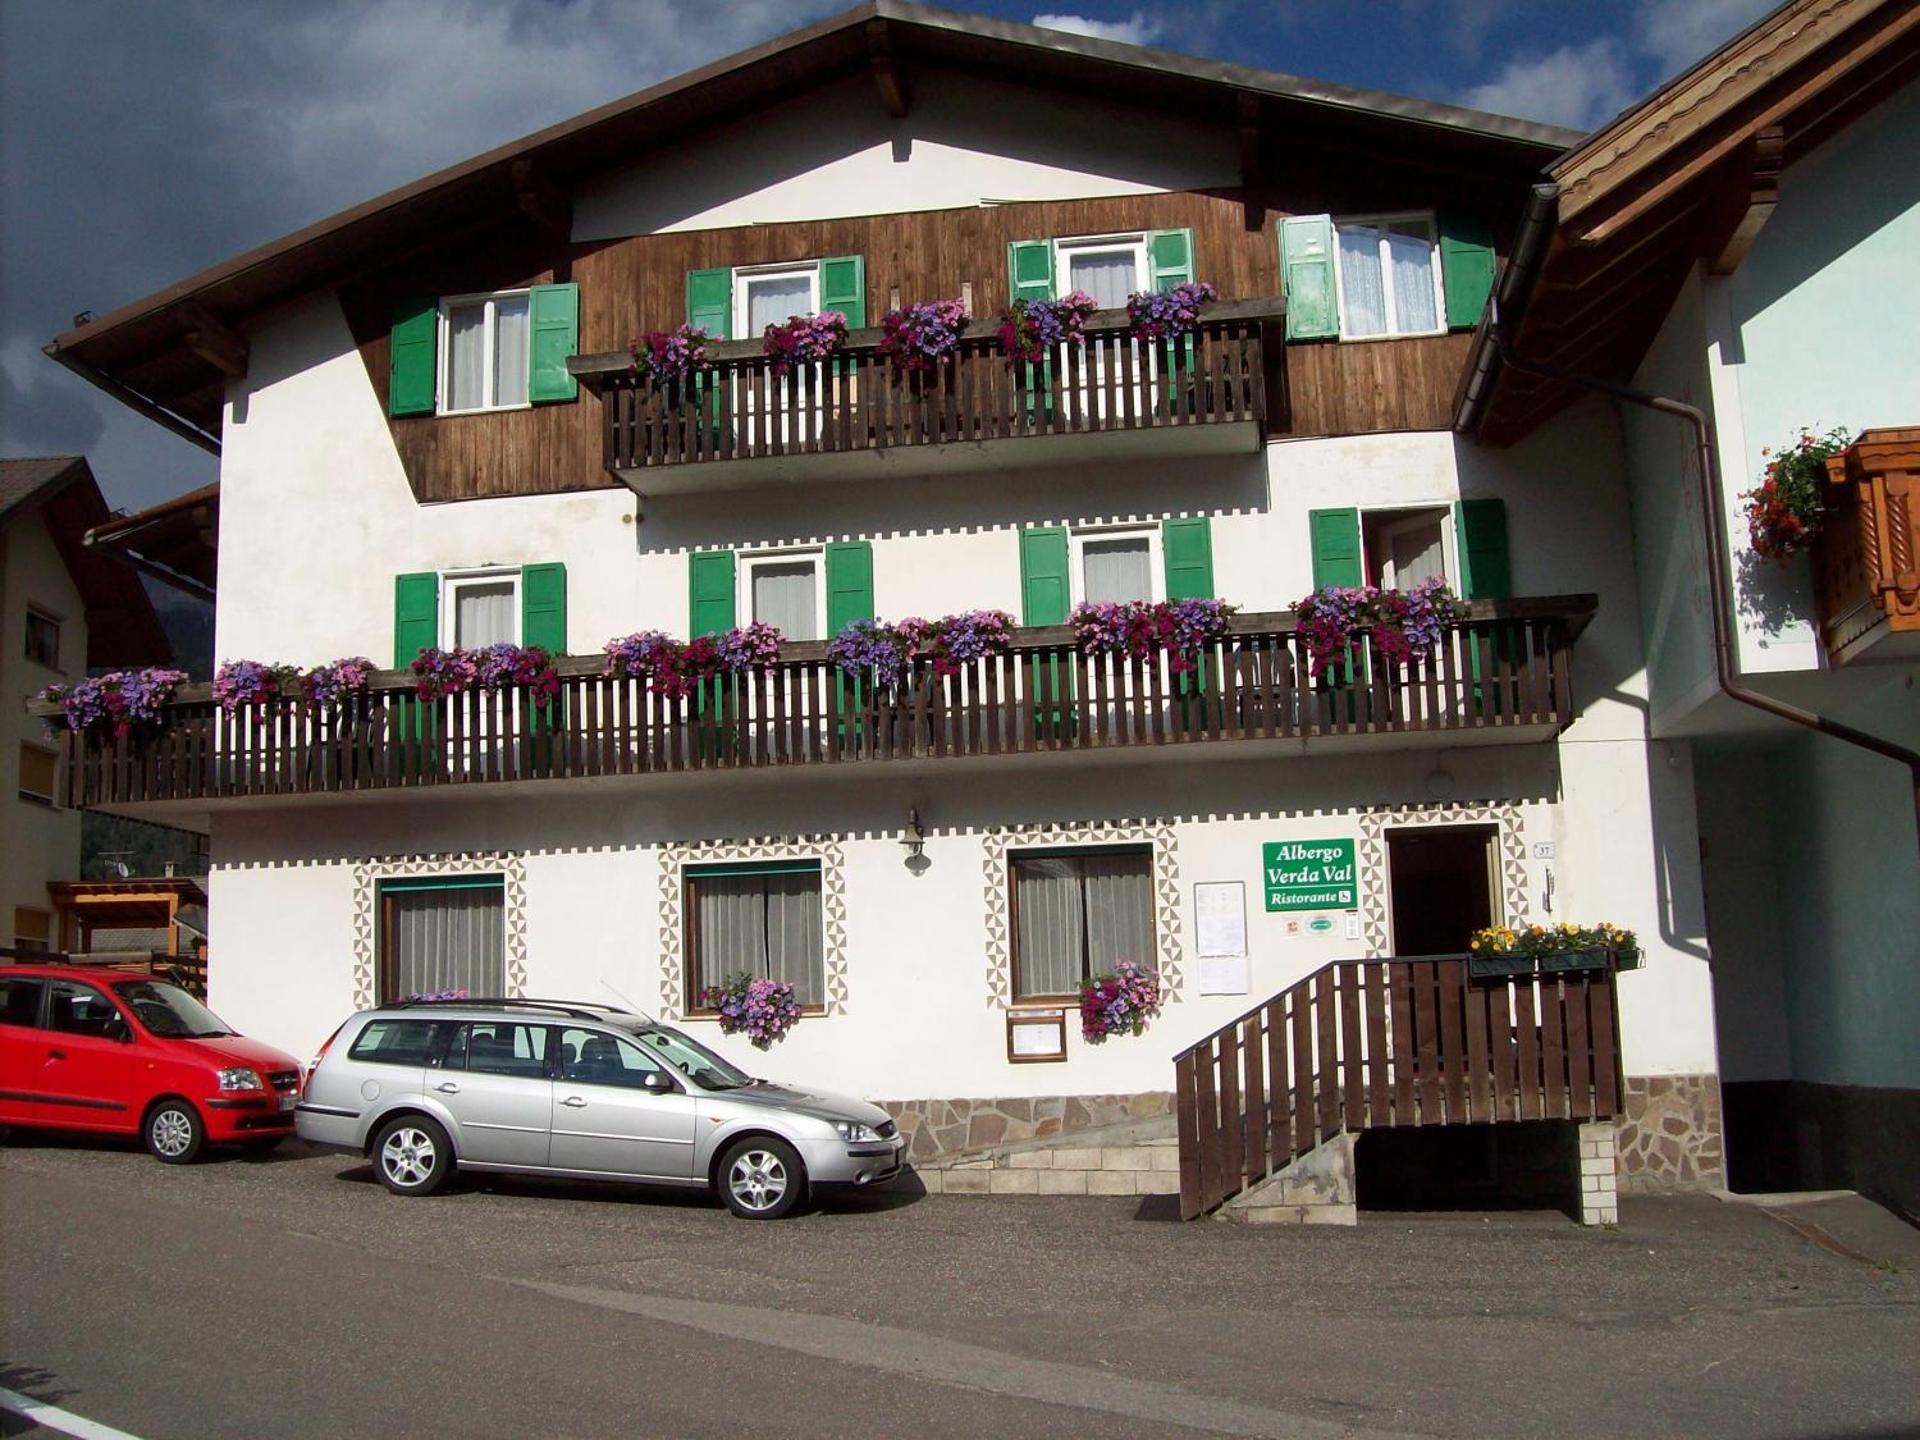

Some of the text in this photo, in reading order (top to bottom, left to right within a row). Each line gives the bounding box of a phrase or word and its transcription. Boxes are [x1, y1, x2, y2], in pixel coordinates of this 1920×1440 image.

[1276, 844, 1343, 863] Albergo
[1267, 863, 1352, 884] Verda Val
[1271, 892, 1337, 905] Ristorante
